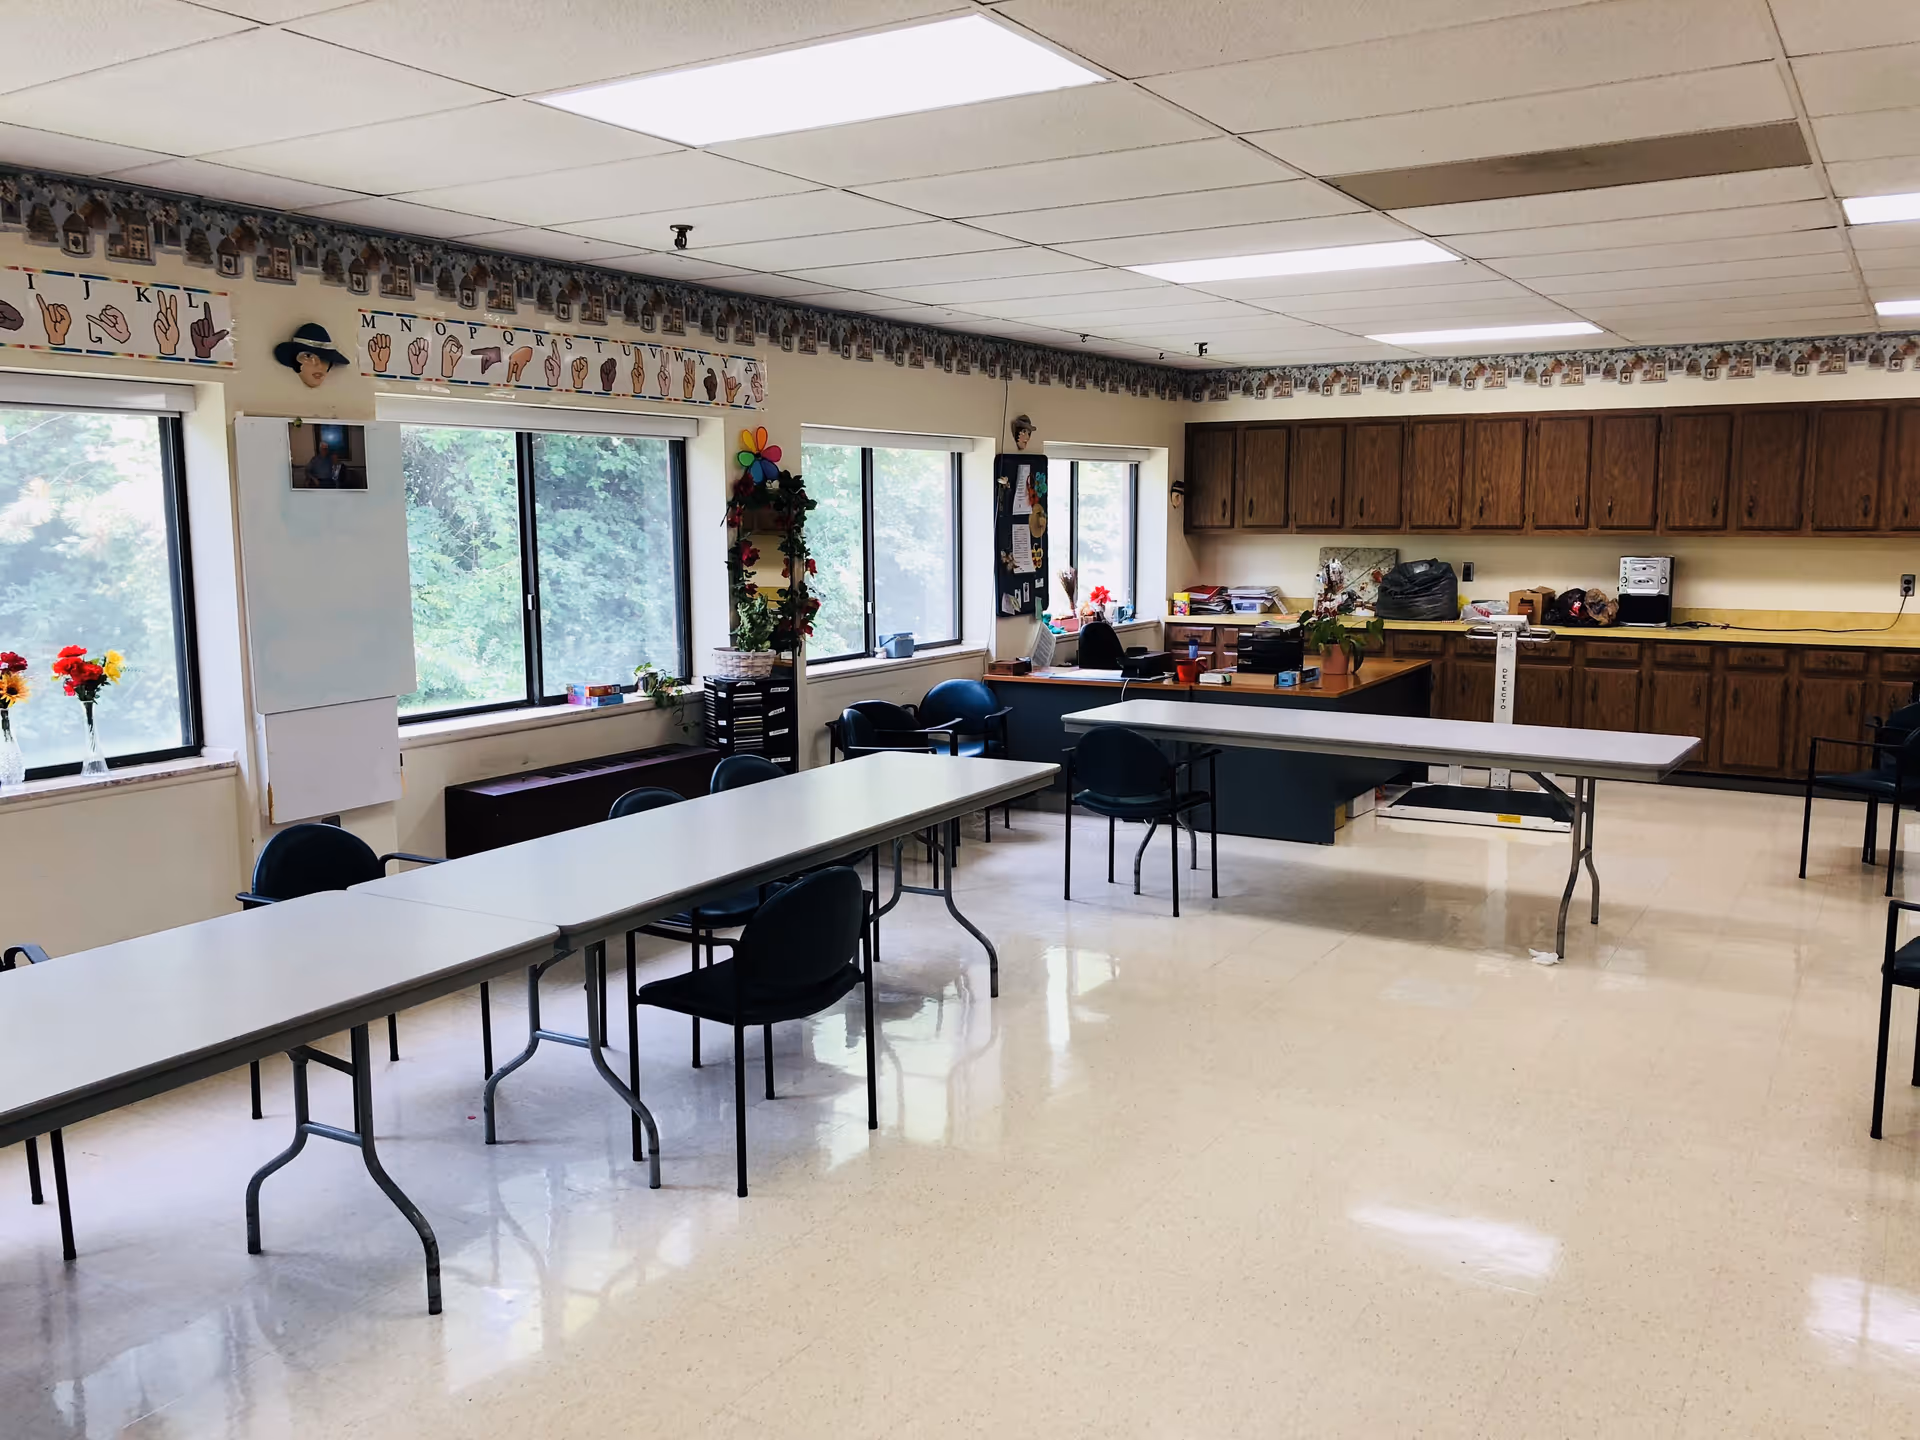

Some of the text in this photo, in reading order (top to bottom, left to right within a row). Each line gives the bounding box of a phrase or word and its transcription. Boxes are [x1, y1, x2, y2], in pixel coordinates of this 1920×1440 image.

[26, 274, 198, 308] I J K L
[362, 314, 730, 368] M N O P Q R S T U V W X Y
[744, 394, 750, 406] Z
